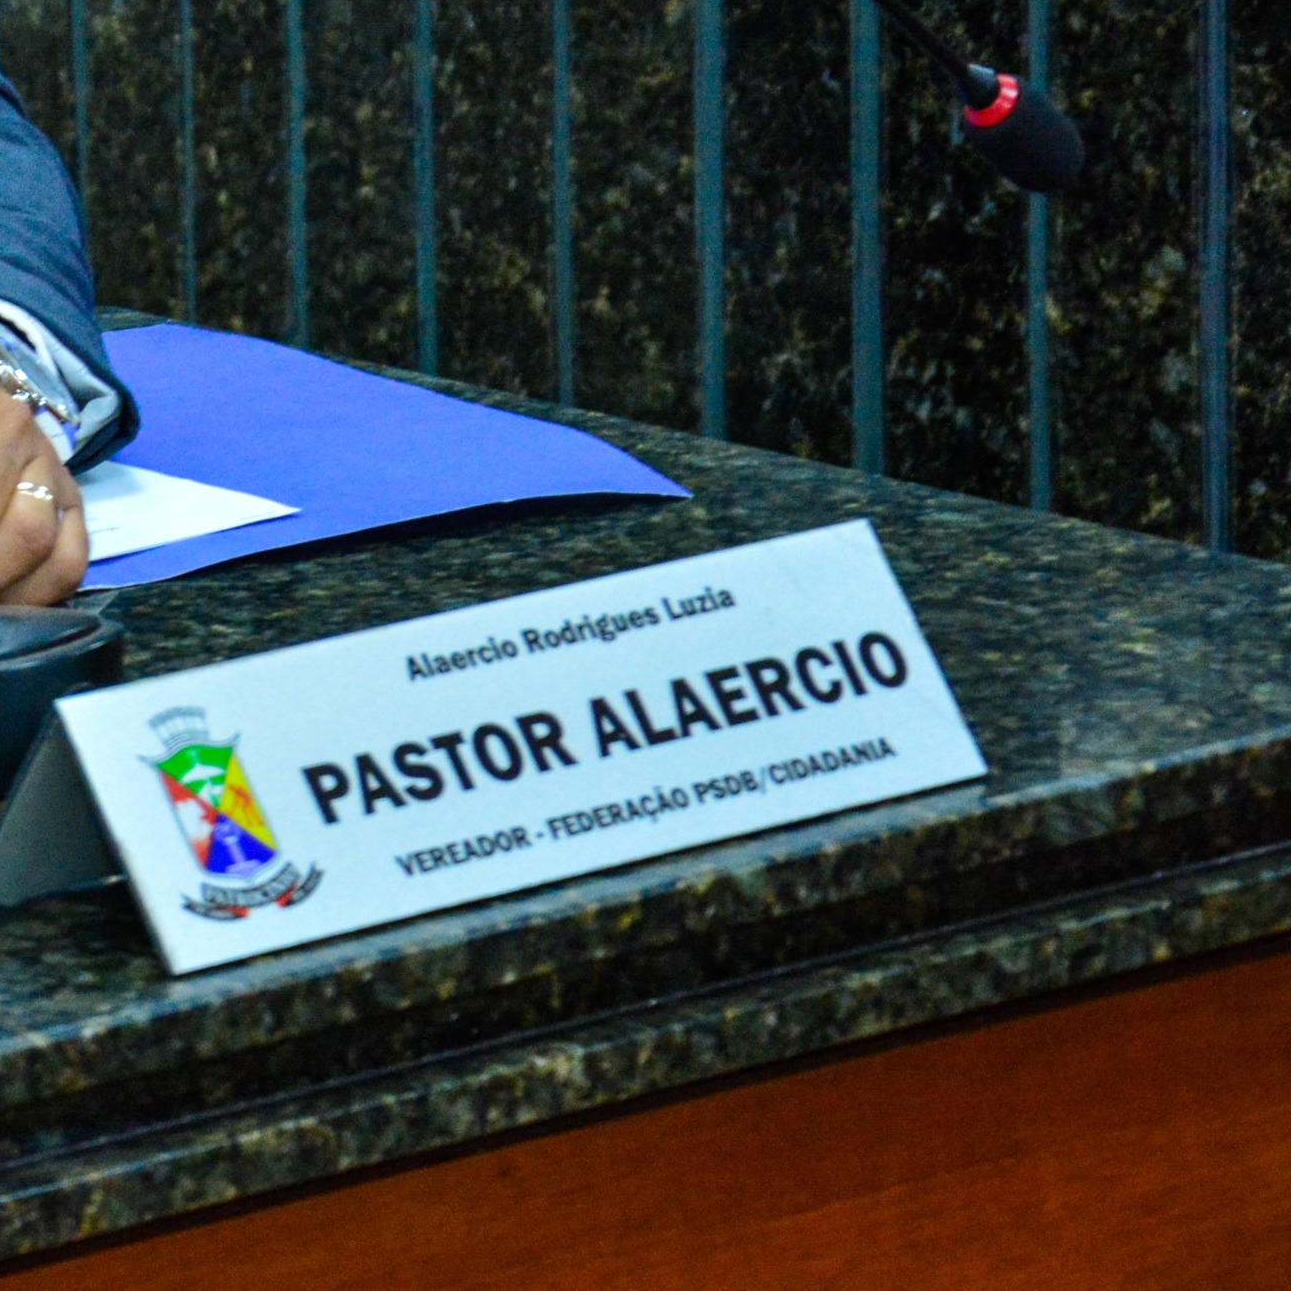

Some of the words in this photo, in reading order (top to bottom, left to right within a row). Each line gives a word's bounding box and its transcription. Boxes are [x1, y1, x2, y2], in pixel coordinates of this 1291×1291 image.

[406, 636, 518, 680] Alaercio
[521, 606, 660, 643] Rodrigues
[661, 586, 735, 621] Luzia
[301, 711, 577, 825] PASTOR
[589, 631, 908, 758] ALAERCIO
[395, 828, 531, 877] VEREADOR
[549, 784, 691, 840] FEDERAÇÃO
[695, 736, 896, 805] PSDB/CIDADANIA
